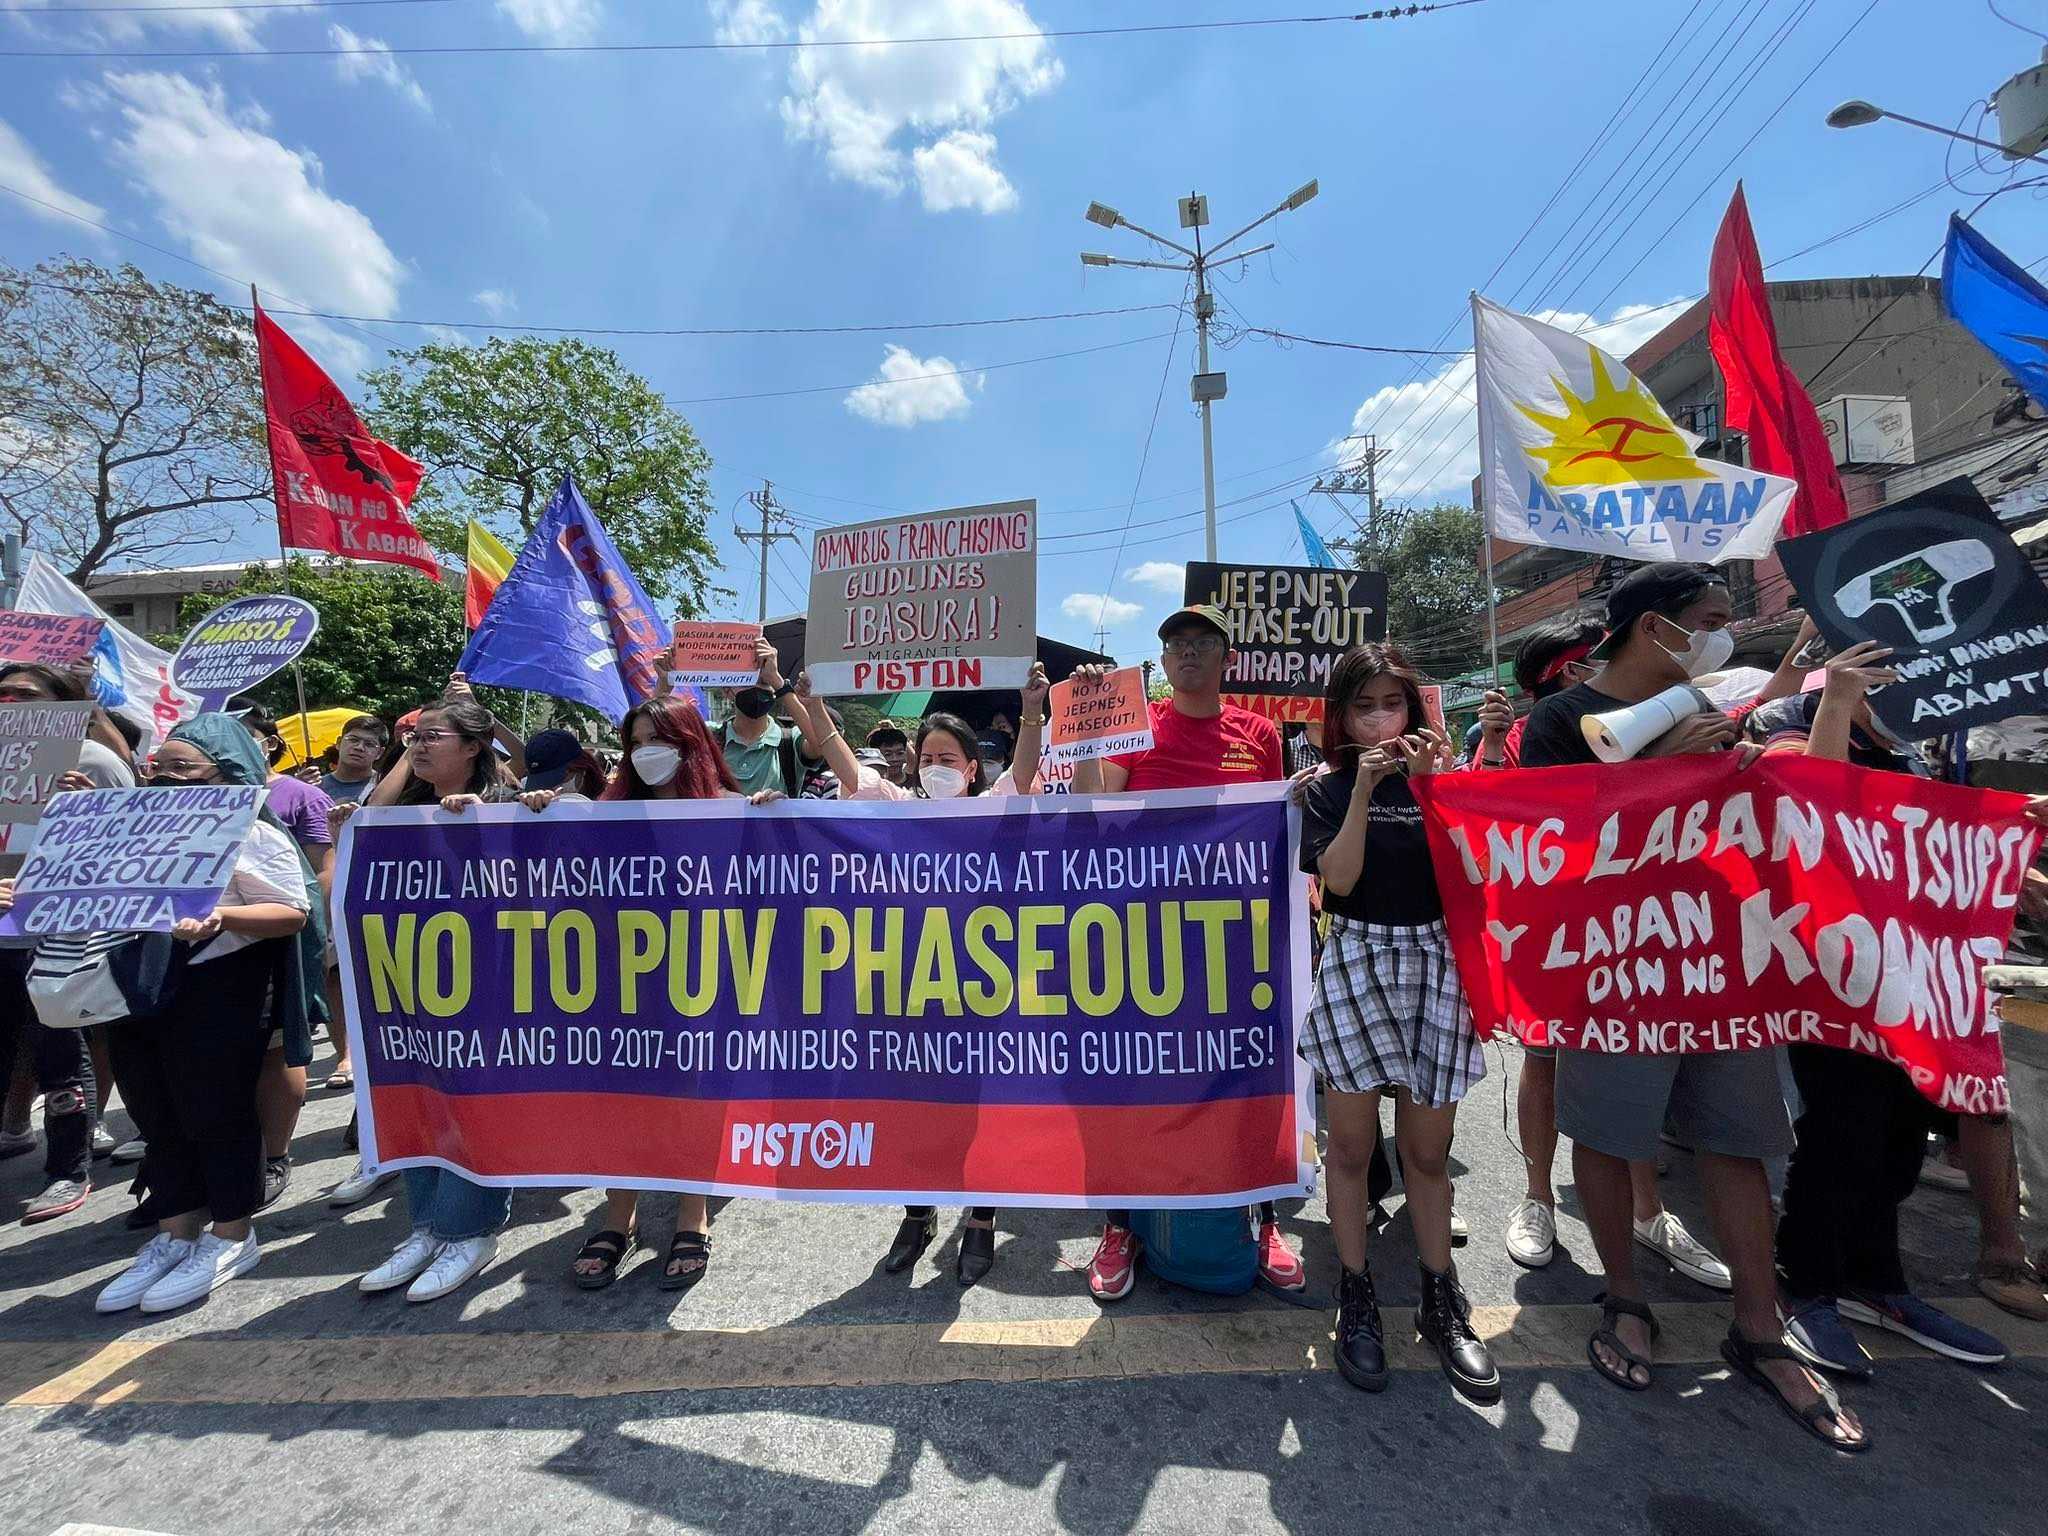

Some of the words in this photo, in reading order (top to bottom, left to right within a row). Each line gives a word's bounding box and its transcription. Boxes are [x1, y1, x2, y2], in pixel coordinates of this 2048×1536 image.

[361, 498, 388, 521] NG
[818, 528, 890, 571] OMNIBUS
[898, 512, 1028, 562] FRANCHISING
[844, 561, 986, 601] GUIDLINES
[1210, 570, 1358, 610] JEEPNEY
[218, 603, 284, 623] SUMAMA
[842, 594, 1001, 650] IBASURA!
[1227, 606, 1373, 646] HASE-OUT
[0, 630, 32, 641] YAW
[192, 620, 276, 646] MARSO
[272, 617, 297, 641] 8
[678, 641, 755, 651] MODERNIZATION
[180, 641, 303, 661] PANDAIGDIGANG
[868, 645, 962, 661] MIGRANTE
[177, 663, 273, 682] KABABAIHANG
[720, 675, 754, 683] YOUTH
[853, 658, 982, 691] PISTON
[1072, 685, 1090, 698] NO
[1094, 681, 1112, 694] TO
[1063, 695, 1126, 718] JEEPNEY
[1225, 694, 1325, 722] NAKPA
[1059, 711, 1136, 737] PHASEOUT!
[1105, 736, 1145, 752] YOUTH
[39, 816, 126, 846] PUBLIC
[128, 813, 234, 837] UTILITY
[1584, 792, 1825, 884] LABAN
[1835, 811, 1894, 880] NG
[14, 841, 240, 889] PHASEOUT!
[62, 836, 191, 863] VEHICLE
[364, 860, 451, 901] ITIGIL
[460, 858, 518, 898] ANG
[527, 855, 667, 897] MASAKER
[675, 855, 713, 896] SA
[724, 853, 819, 895] AMING
[830, 851, 1003, 894] PRANGKISA
[1013, 850, 1050, 892] AT
[1062, 841, 1271, 891] KABUHAYAN!
[24, 895, 178, 934] GABRIELA
[1542, 890, 1714, 969] LABAN
[362, 910, 472, 1018] NO
[496, 908, 598, 1014] TO
[617, 907, 778, 1017] PUV
[802, 898, 1274, 1018] PHASEOUT!
[1681, 954, 1726, 997] NG
[379, 1025, 486, 1068] IBASURA
[496, 1026, 556, 1066] ANG
[567, 1026, 601, 1066] DO
[610, 1028, 714, 1071] 2017-011
[725, 1028, 858, 1072] OMNIBUS
[867, 1030, 1069, 1077] FRANCHISING
[1079, 1025, 1275, 1077] GUIDELINES!
[1638, 1016, 1762, 1054] NCR-LFS
[731, 1119, 875, 1169] PISTON
